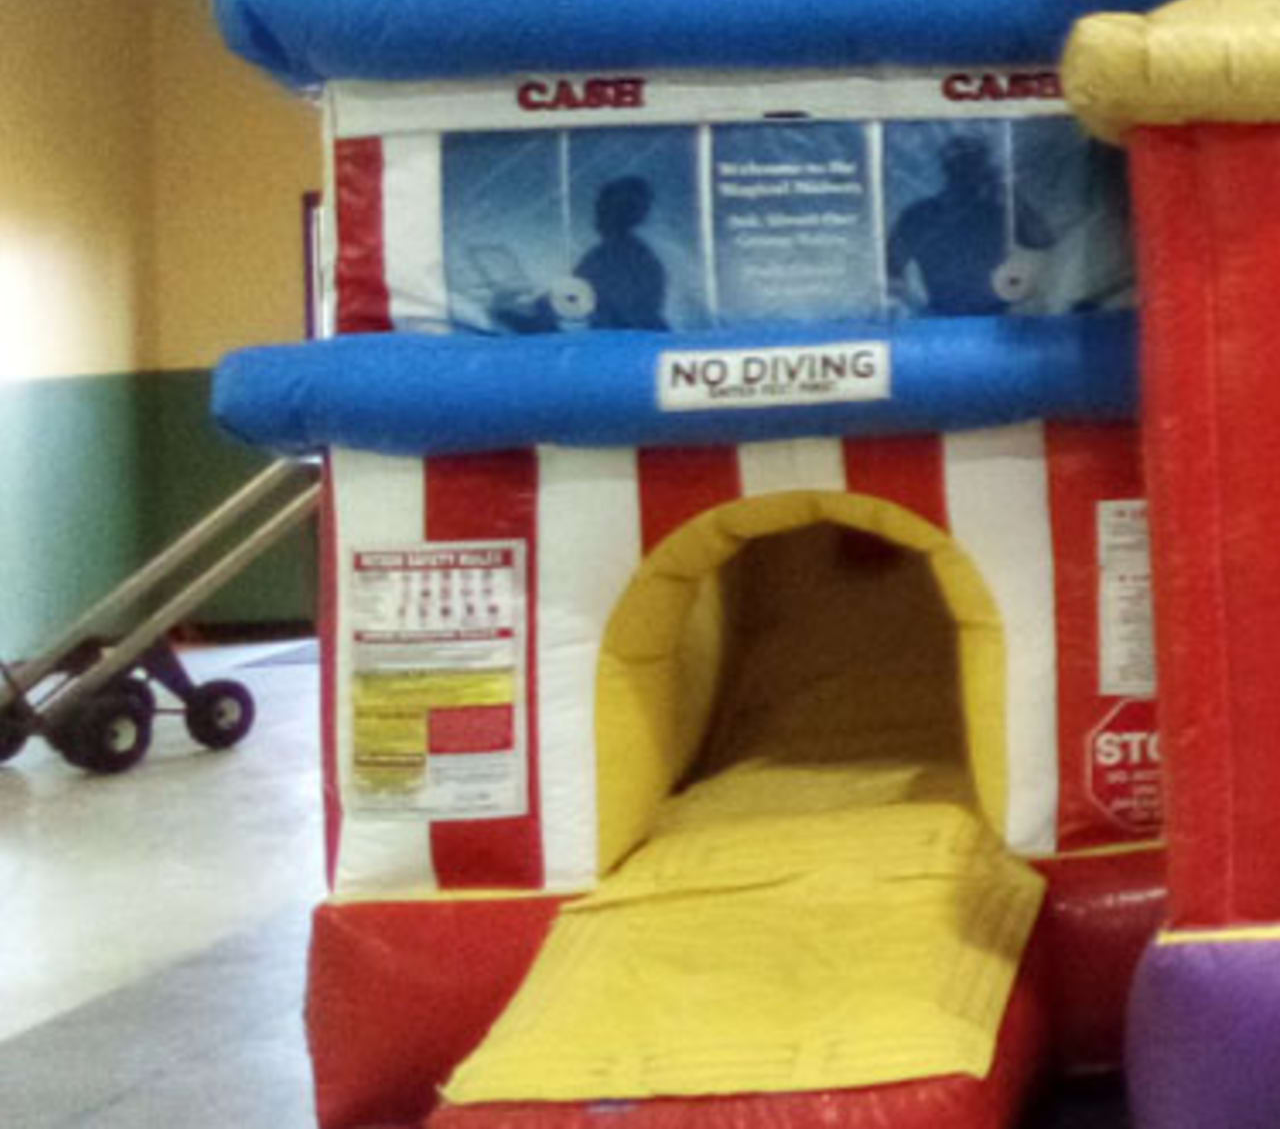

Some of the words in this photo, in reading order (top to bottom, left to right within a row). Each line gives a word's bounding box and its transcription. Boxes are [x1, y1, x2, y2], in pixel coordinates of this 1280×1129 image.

[517, 78, 646, 111] CASH
[941, 72, 1068, 101] CASH
[671, 359, 728, 388] NO
[742, 349, 876, 386] DIVING
[1096, 731, 1160, 765] ST
